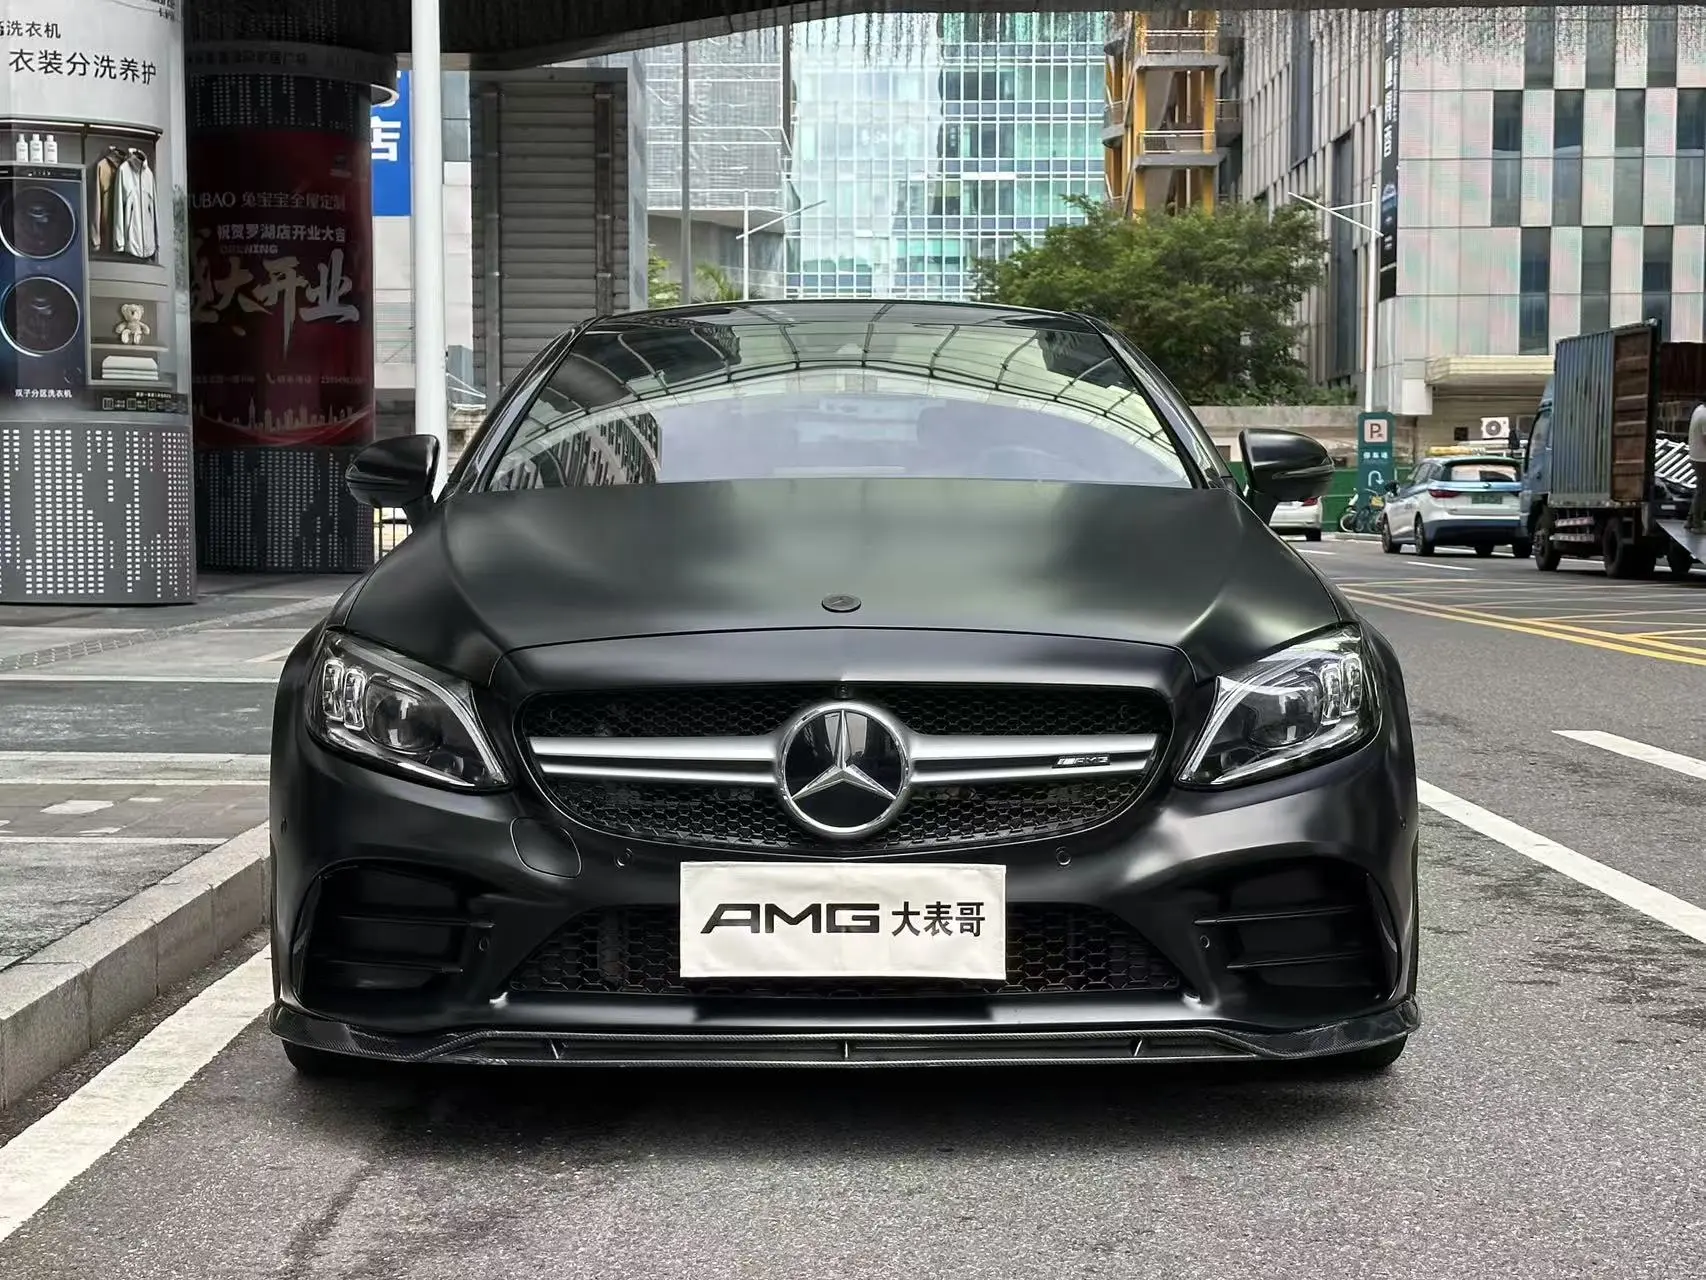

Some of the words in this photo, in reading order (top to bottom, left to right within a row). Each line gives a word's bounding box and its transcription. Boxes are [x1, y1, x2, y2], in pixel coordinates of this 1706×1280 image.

[9, 48, 157, 85] 衣装分洗养护
[15, 389, 73, 399] 双子分区洗衣机
[1370, 423, 1381, 438] P
[700, 903, 880, 934] AMG
[891, 901, 986, 937] 大表哥
